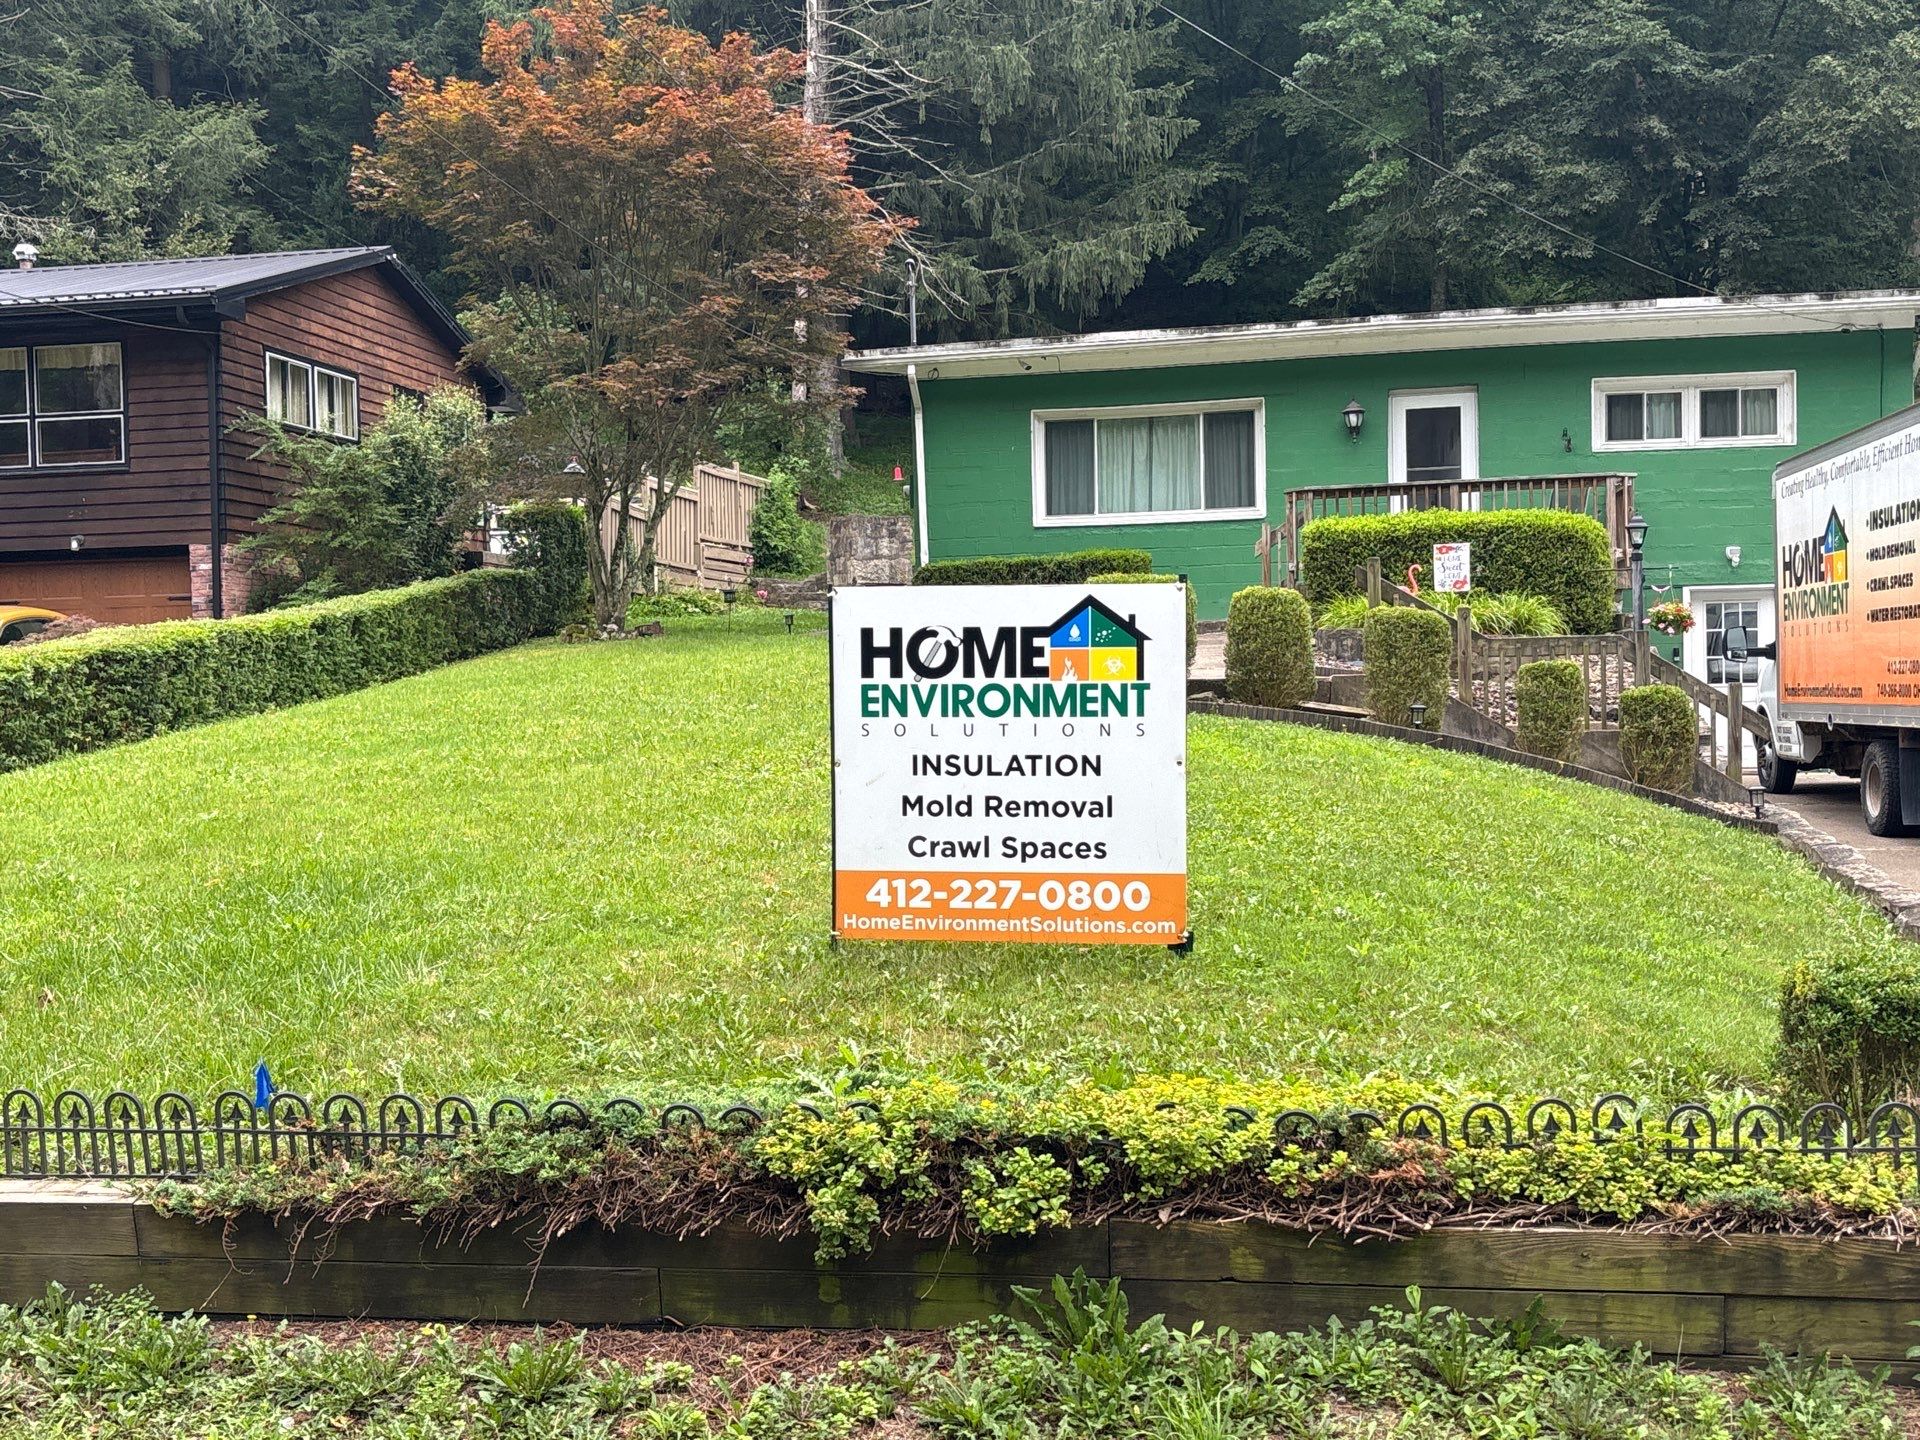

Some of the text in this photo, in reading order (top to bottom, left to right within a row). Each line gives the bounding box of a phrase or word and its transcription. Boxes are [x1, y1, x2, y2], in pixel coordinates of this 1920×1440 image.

[1781, 479, 1804, 499] Creating
[1805, 467, 1829, 489] Healthy,
[1830, 450, 1871, 483] Comfortable,
[1873, 438, 1903, 472] Efficient
[1782, 535, 1825, 589] HOME
[1870, 539, 1916, 562] MOLD REMOVAL
[1870, 572, 1914, 592] CRAWL SPACES
[1783, 582, 1849, 622] ENVIRONMENT
[1870, 607, 1890, 623] WATER
[1783, 620, 1849, 638] SOLUTIONS
[860, 625, 1051, 681] HOME
[860, 682, 1151, 718] ENVIRONMENT
[861, 723, 1146, 737] SOLUTIONS
[911, 754, 1102, 777] INSULATION
[901, 795, 1113, 818] Mold Removal
[907, 835, 1108, 863] Crawl Spaces
[865, 878, 1151, 912] 412-227-0800
[843, 914, 1177, 935] HomeEnvironmentSolutions.com
